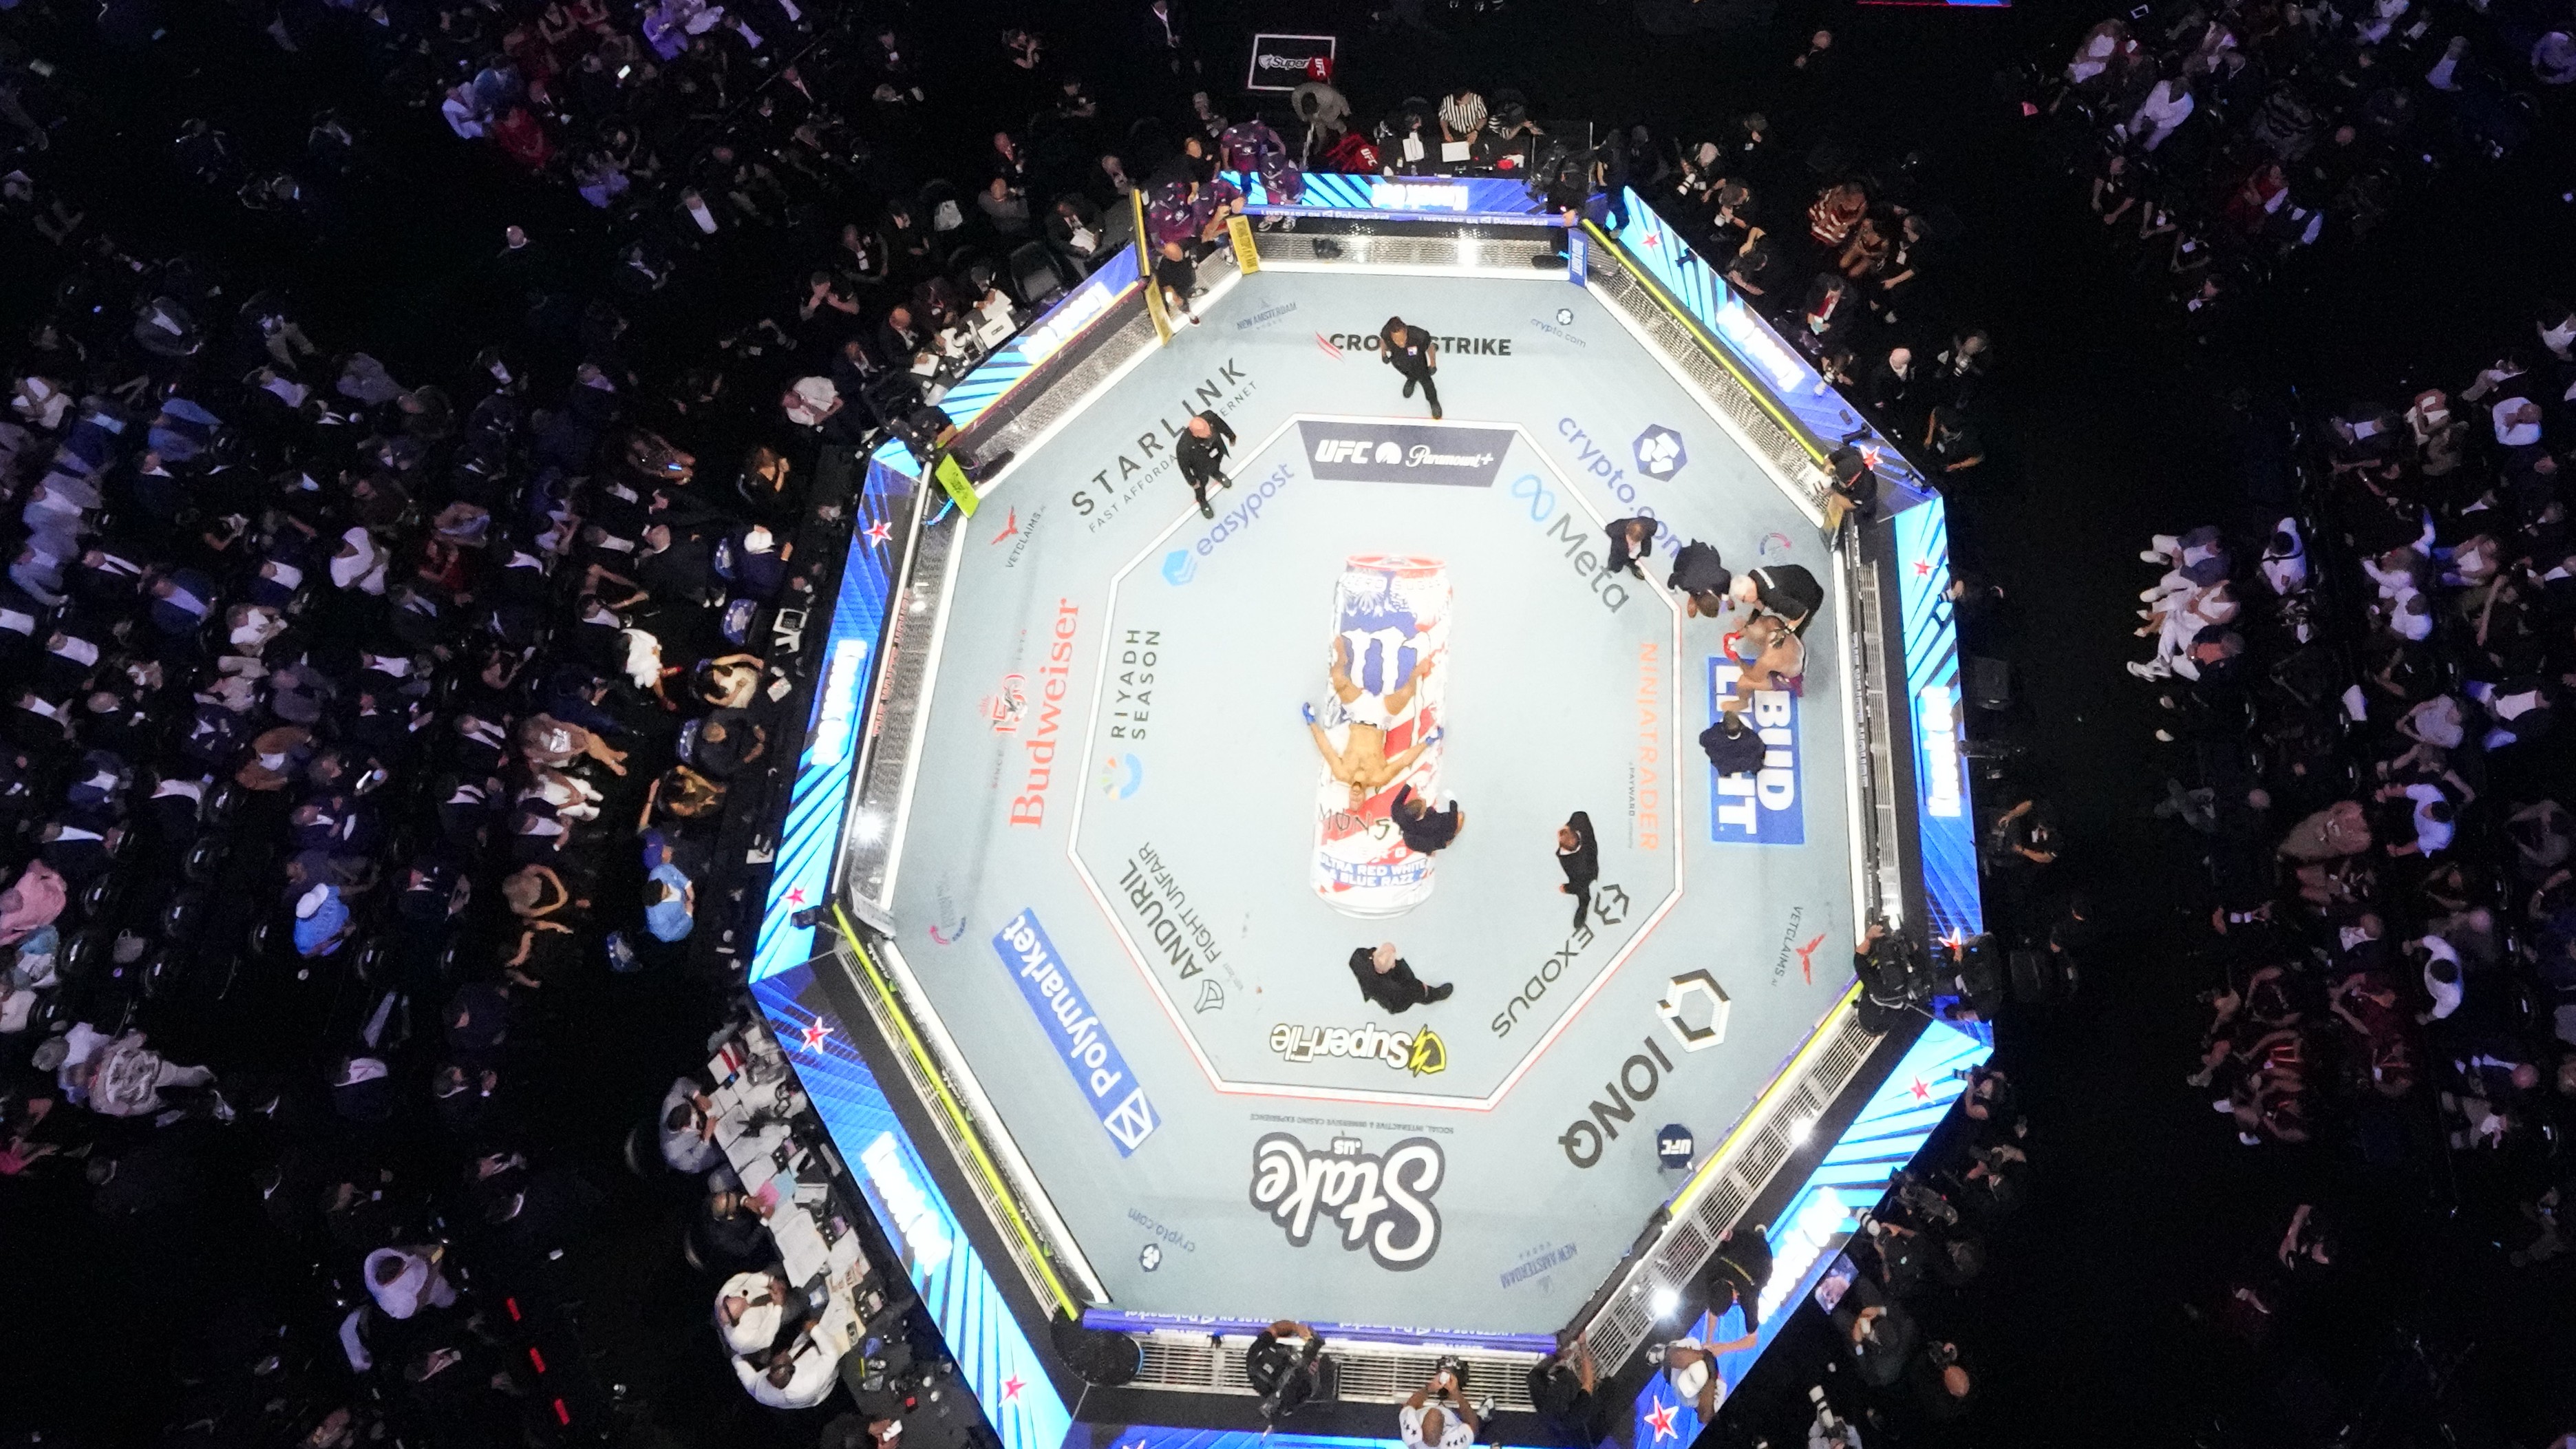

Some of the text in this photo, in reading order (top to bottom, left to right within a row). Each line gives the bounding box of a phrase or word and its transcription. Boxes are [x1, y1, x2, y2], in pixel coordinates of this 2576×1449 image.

[1271, 55, 1312, 70] Super
[1314, 58, 1326, 76] UFC
[1360, 148, 1378, 167] UFC
[1330, 333, 1511, 356] CROTRIKE
[1531, 317, 1586, 348] crypto.com
[1072, 357, 1246, 516] STARLINK
[1314, 440, 1494, 469] UFC Paramount+
[1005, 510, 1041, 569] VETCLAIMS
[1089, 503, 1122, 533] FAST
[1195, 463, 1295, 556] easypost
[1546, 513, 1630, 614] Meta
[1010, 597, 1079, 827] Budweiser
[1111, 630, 1141, 739] RIYADH
[1132, 631, 1160, 740] SEASON
[1637, 642, 1660, 852] NINJATRADER
[1715, 665, 1757, 835] LIHT
[1754, 690, 1794, 811] BUD
[1138, 841, 1222, 964] FIGHT UNFAIR
[1340, 872, 1376, 886] BLUE
[1381, 874, 1414, 886] RAZZ
[1357, 864, 1387, 876] RED
[1390, 860, 1427, 875] WHITE
[1119, 859, 1204, 980] ANDURIL
[1778, 906, 1802, 977] VETCLAIMS
[1003, 914, 1122, 1097] Polymarket
[1491, 924, 1595, 1038] EXODUS
[1270, 1022, 1414, 1070] SuperFile
[1558, 1035, 1674, 1169] IONQ
[1660, 1139, 1692, 1155] UFC
[1127, 1206, 1195, 1254] crypto.com
[1253, 1136, 1443, 1265] Stake
[1500, 1242, 1579, 1289] NEW AMSTERDAM
